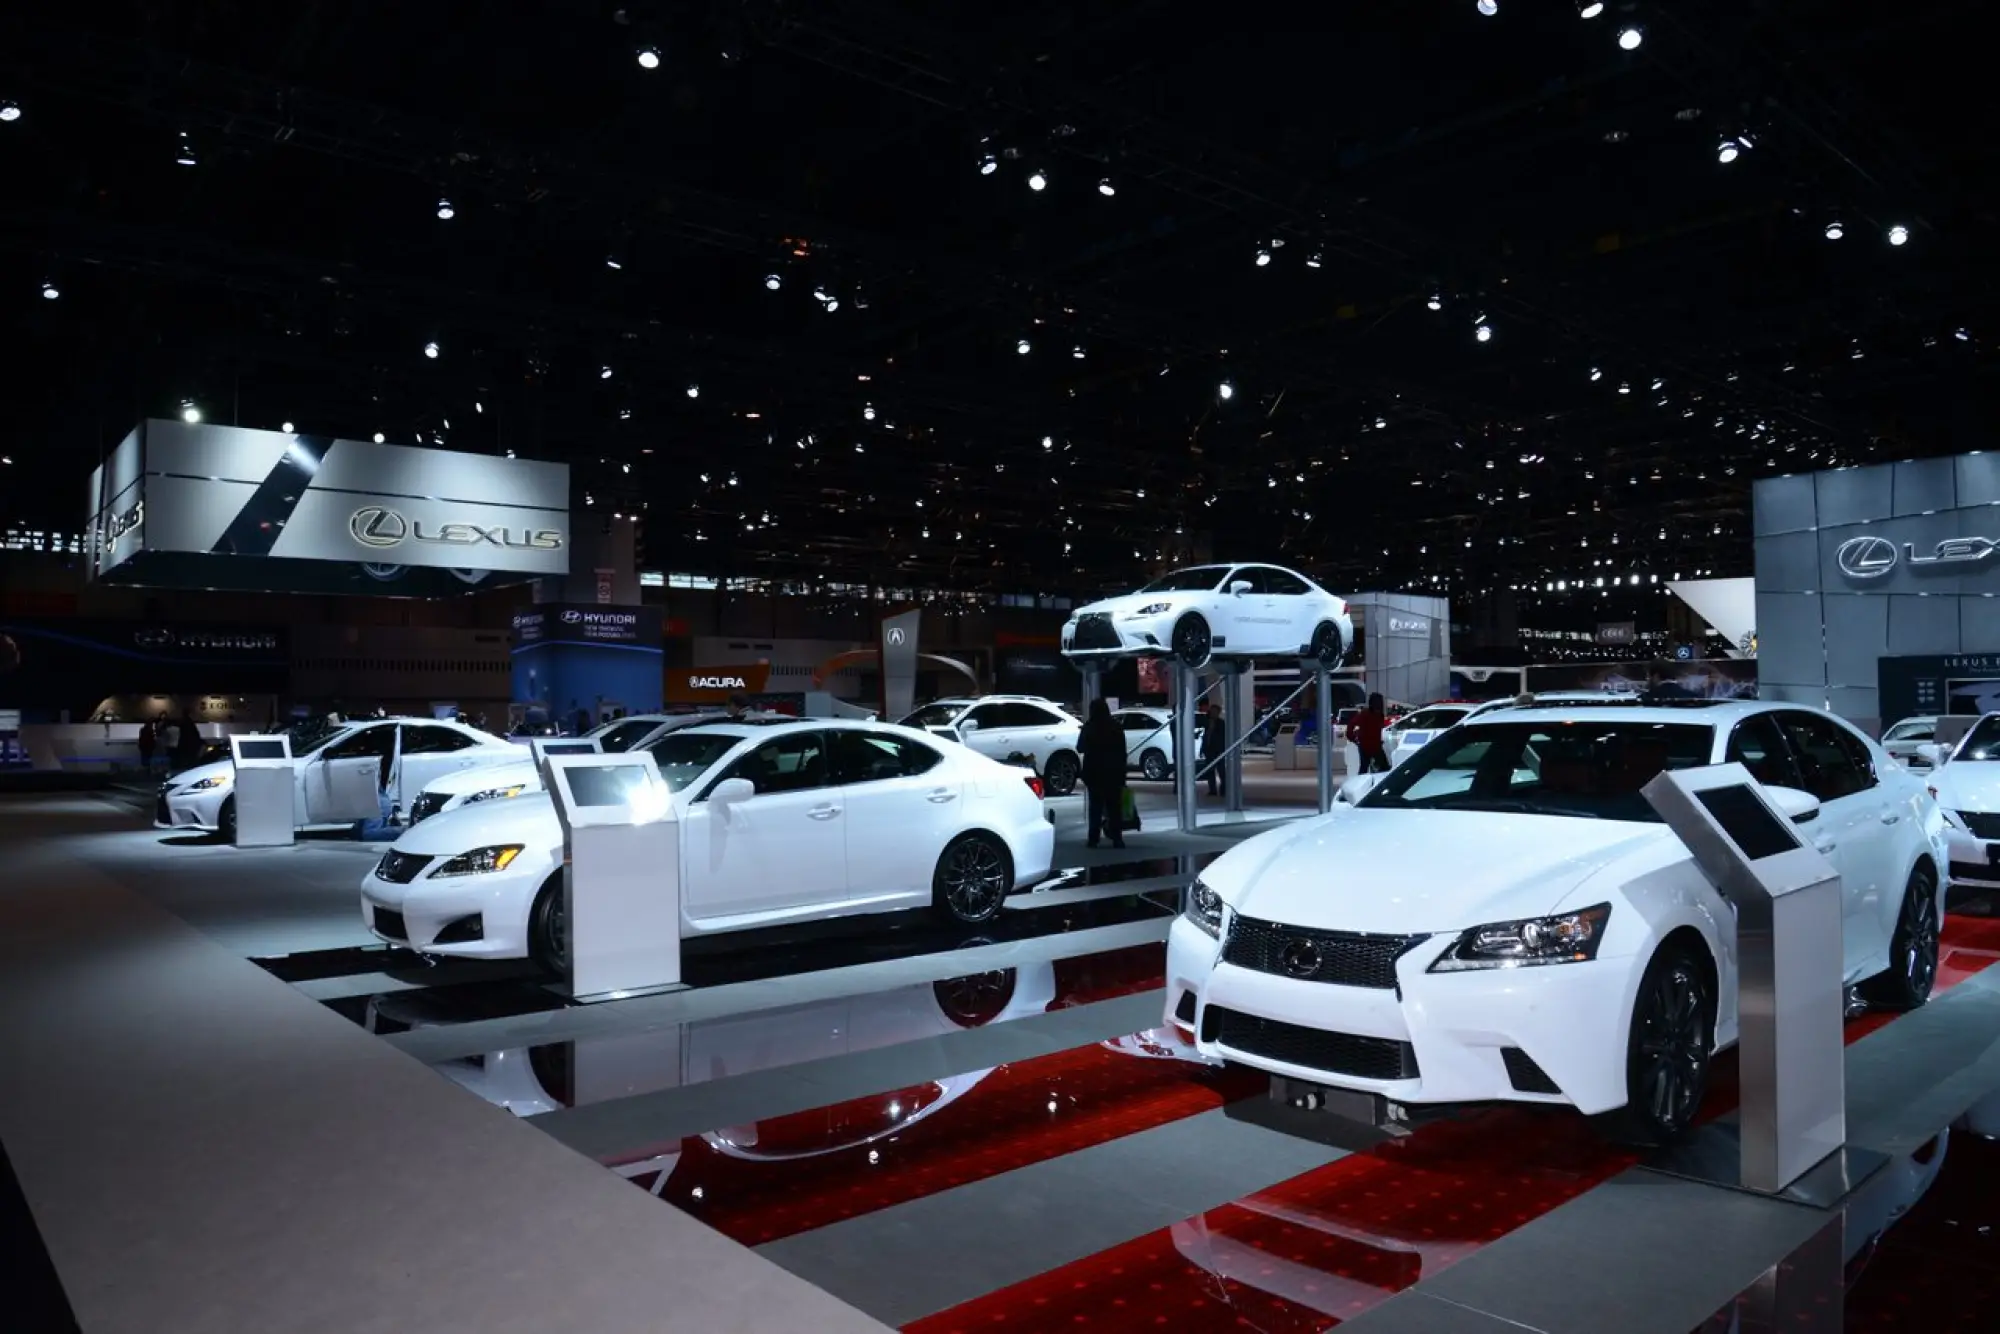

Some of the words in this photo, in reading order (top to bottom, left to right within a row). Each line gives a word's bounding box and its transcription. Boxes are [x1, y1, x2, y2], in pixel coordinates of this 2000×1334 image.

[413, 520, 562, 550] LEXUS
[584, 613, 636, 625] HYUNDAI
[699, 677, 746, 688] ACURA
